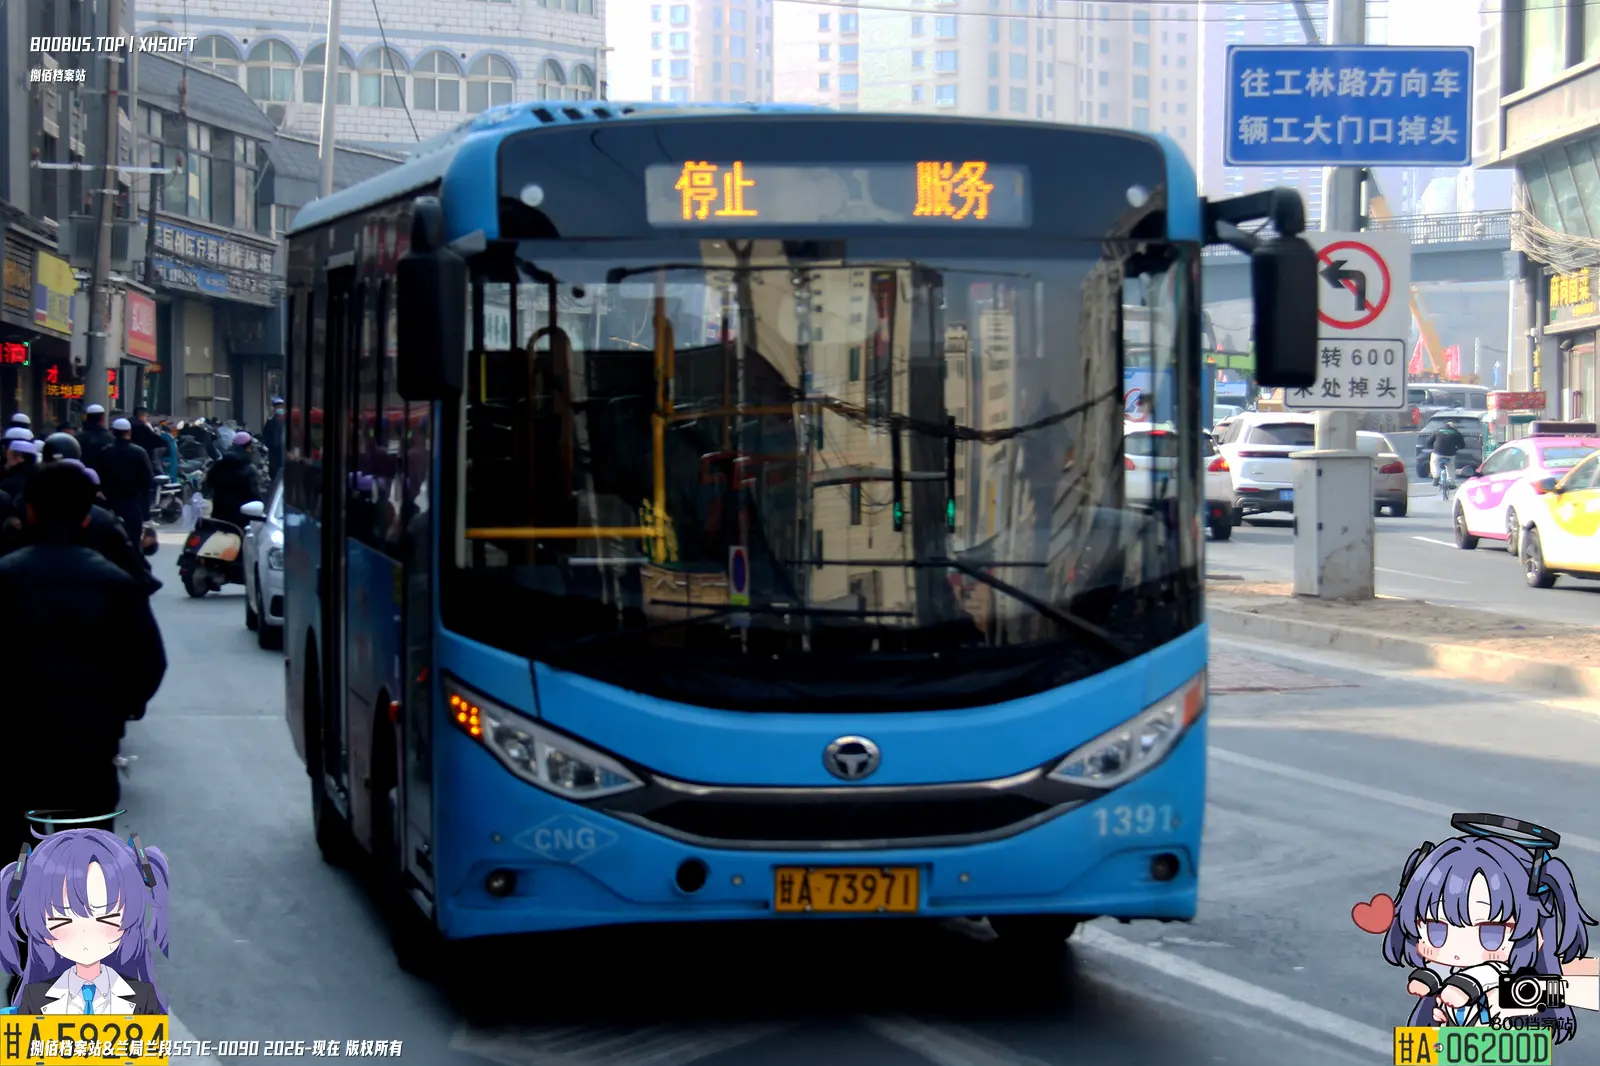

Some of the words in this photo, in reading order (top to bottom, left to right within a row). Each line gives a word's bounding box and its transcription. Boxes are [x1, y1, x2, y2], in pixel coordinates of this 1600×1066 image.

[1240, 67, 1460, 98] 往工林路方向车
[1238, 115, 1458, 145] 辆工大门口掉头
[674, 160, 759, 220] 停止
[912, 160, 993, 220] 服务
[1093, 803, 1172, 836] 1391
[534, 827, 596, 850] CNG
